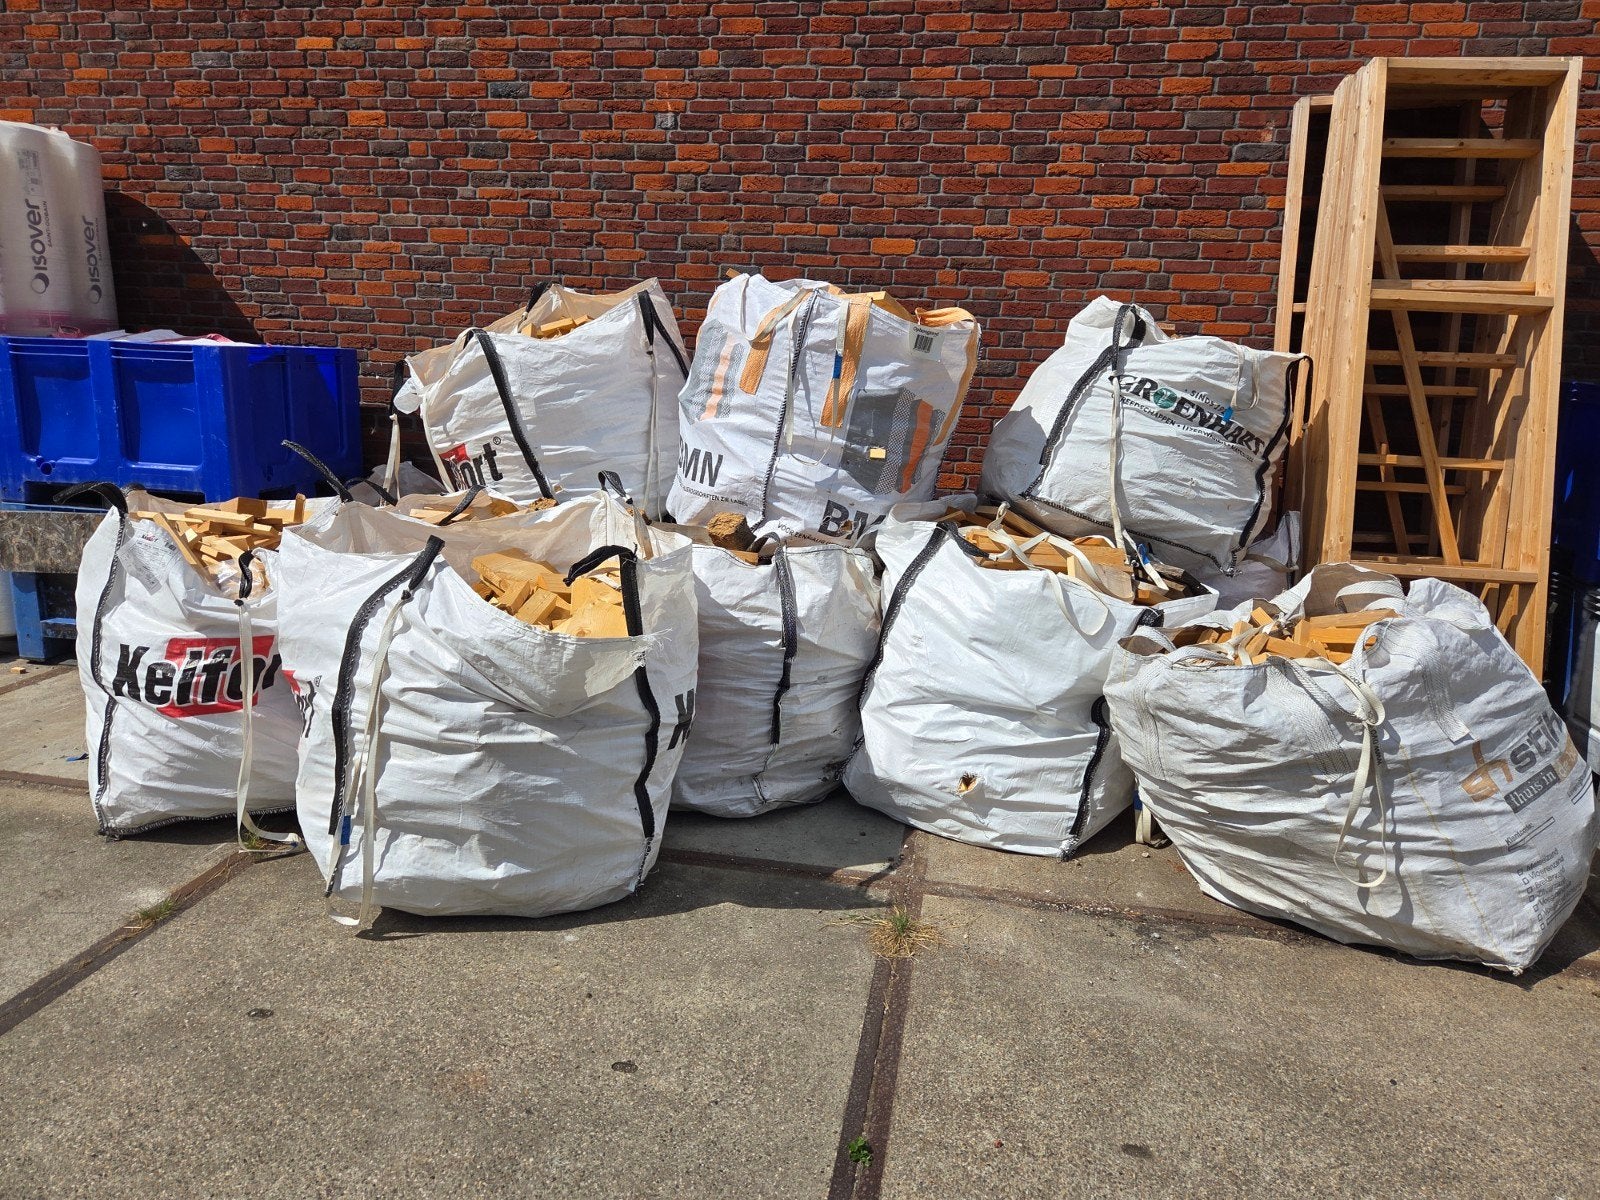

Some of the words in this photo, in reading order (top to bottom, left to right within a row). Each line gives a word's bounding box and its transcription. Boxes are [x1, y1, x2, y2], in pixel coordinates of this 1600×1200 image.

[1189, 389, 1215, 407] SINDS
[777, 522, 794, 536] VOOR
[1509, 778, 1543, 807] thuis
[1540, 771, 1557, 785] in
